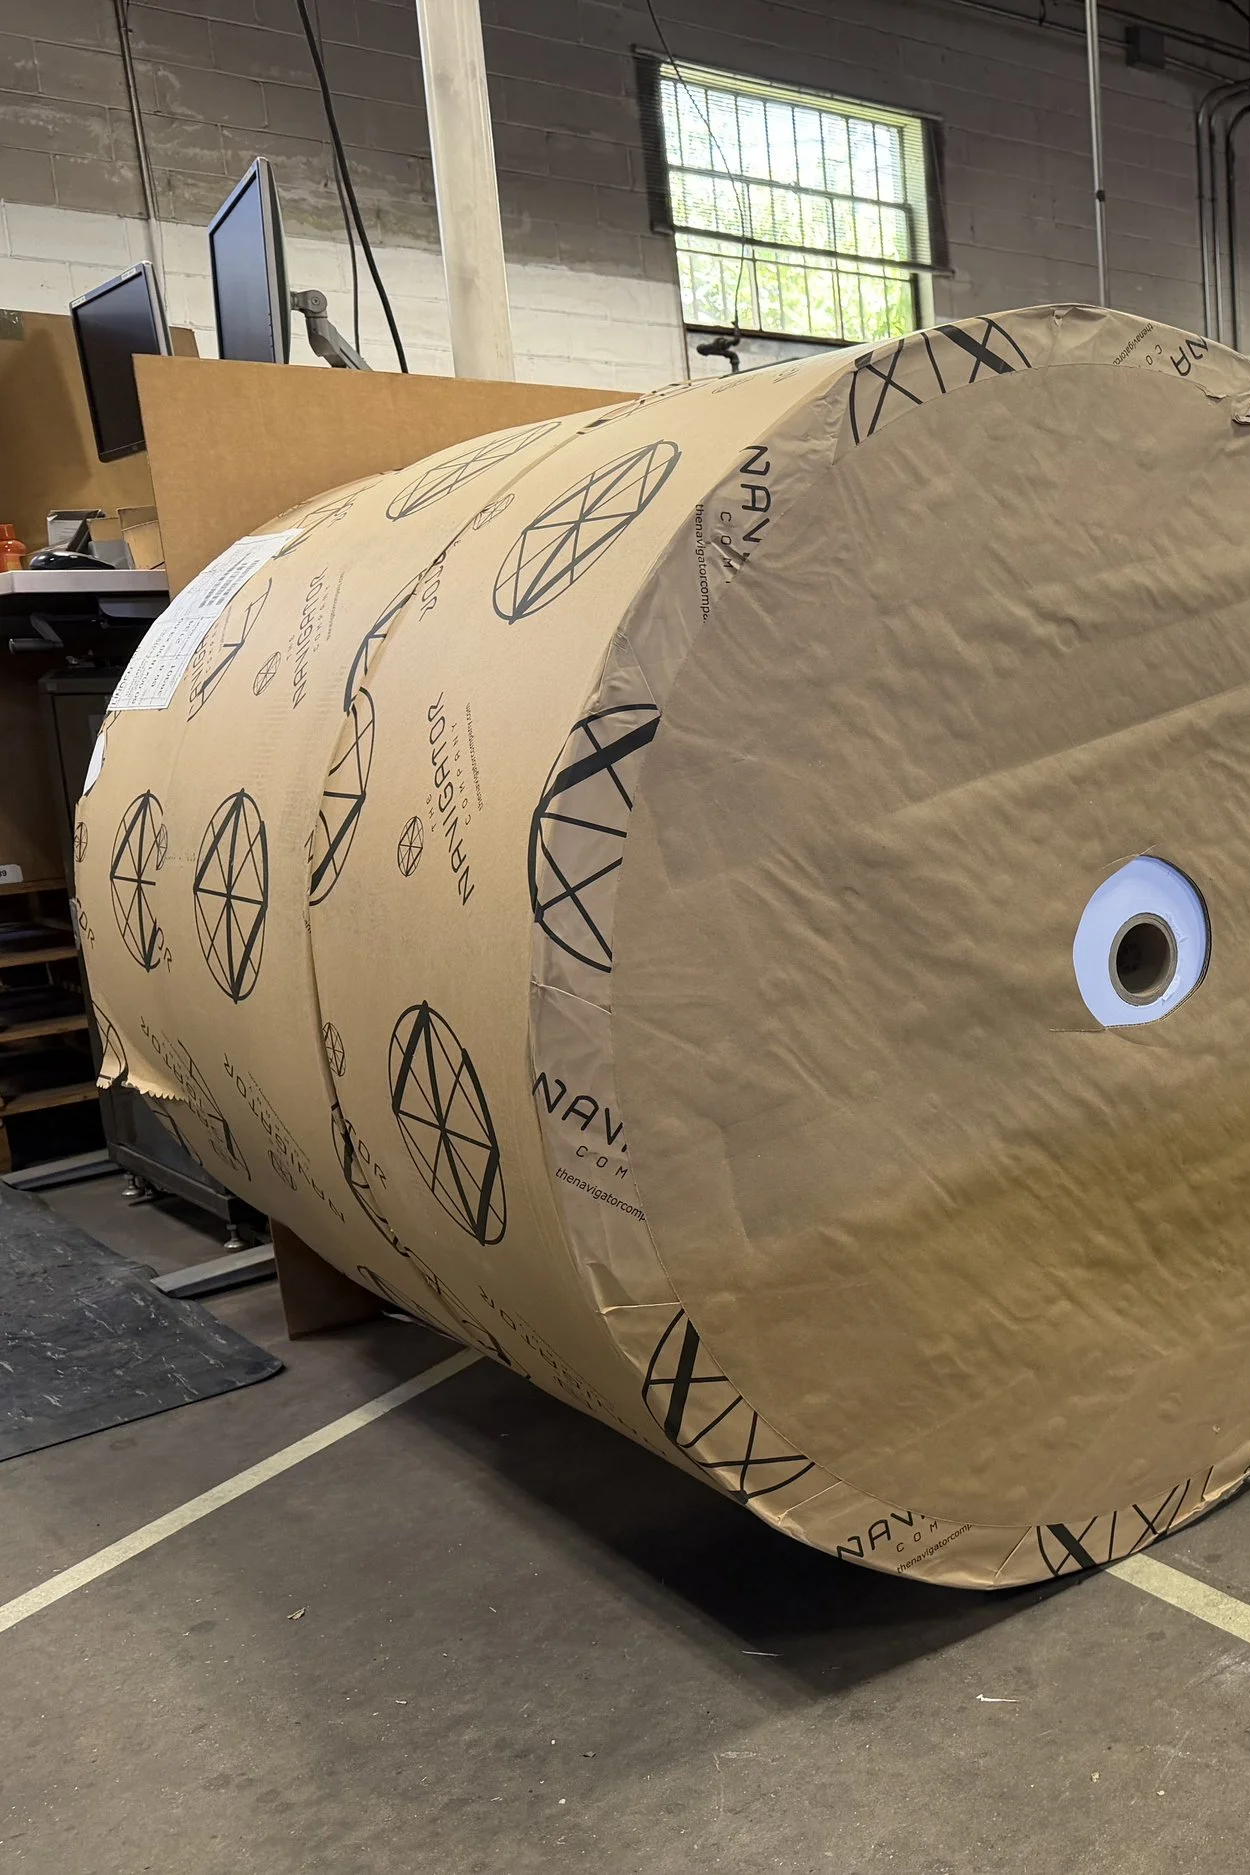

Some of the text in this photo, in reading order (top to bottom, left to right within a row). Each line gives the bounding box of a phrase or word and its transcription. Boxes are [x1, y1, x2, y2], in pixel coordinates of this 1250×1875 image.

[739, 445, 772, 561] NAV
[292, 566, 329, 710] NAVIGATOR
[426, 794, 437, 833] THE
[428, 691, 475, 906] NAVIGATOR
[451, 722, 471, 826] COMPANY
[532, 1072, 628, 1153] NAV
[836, 1511, 926, 1559] NAV
